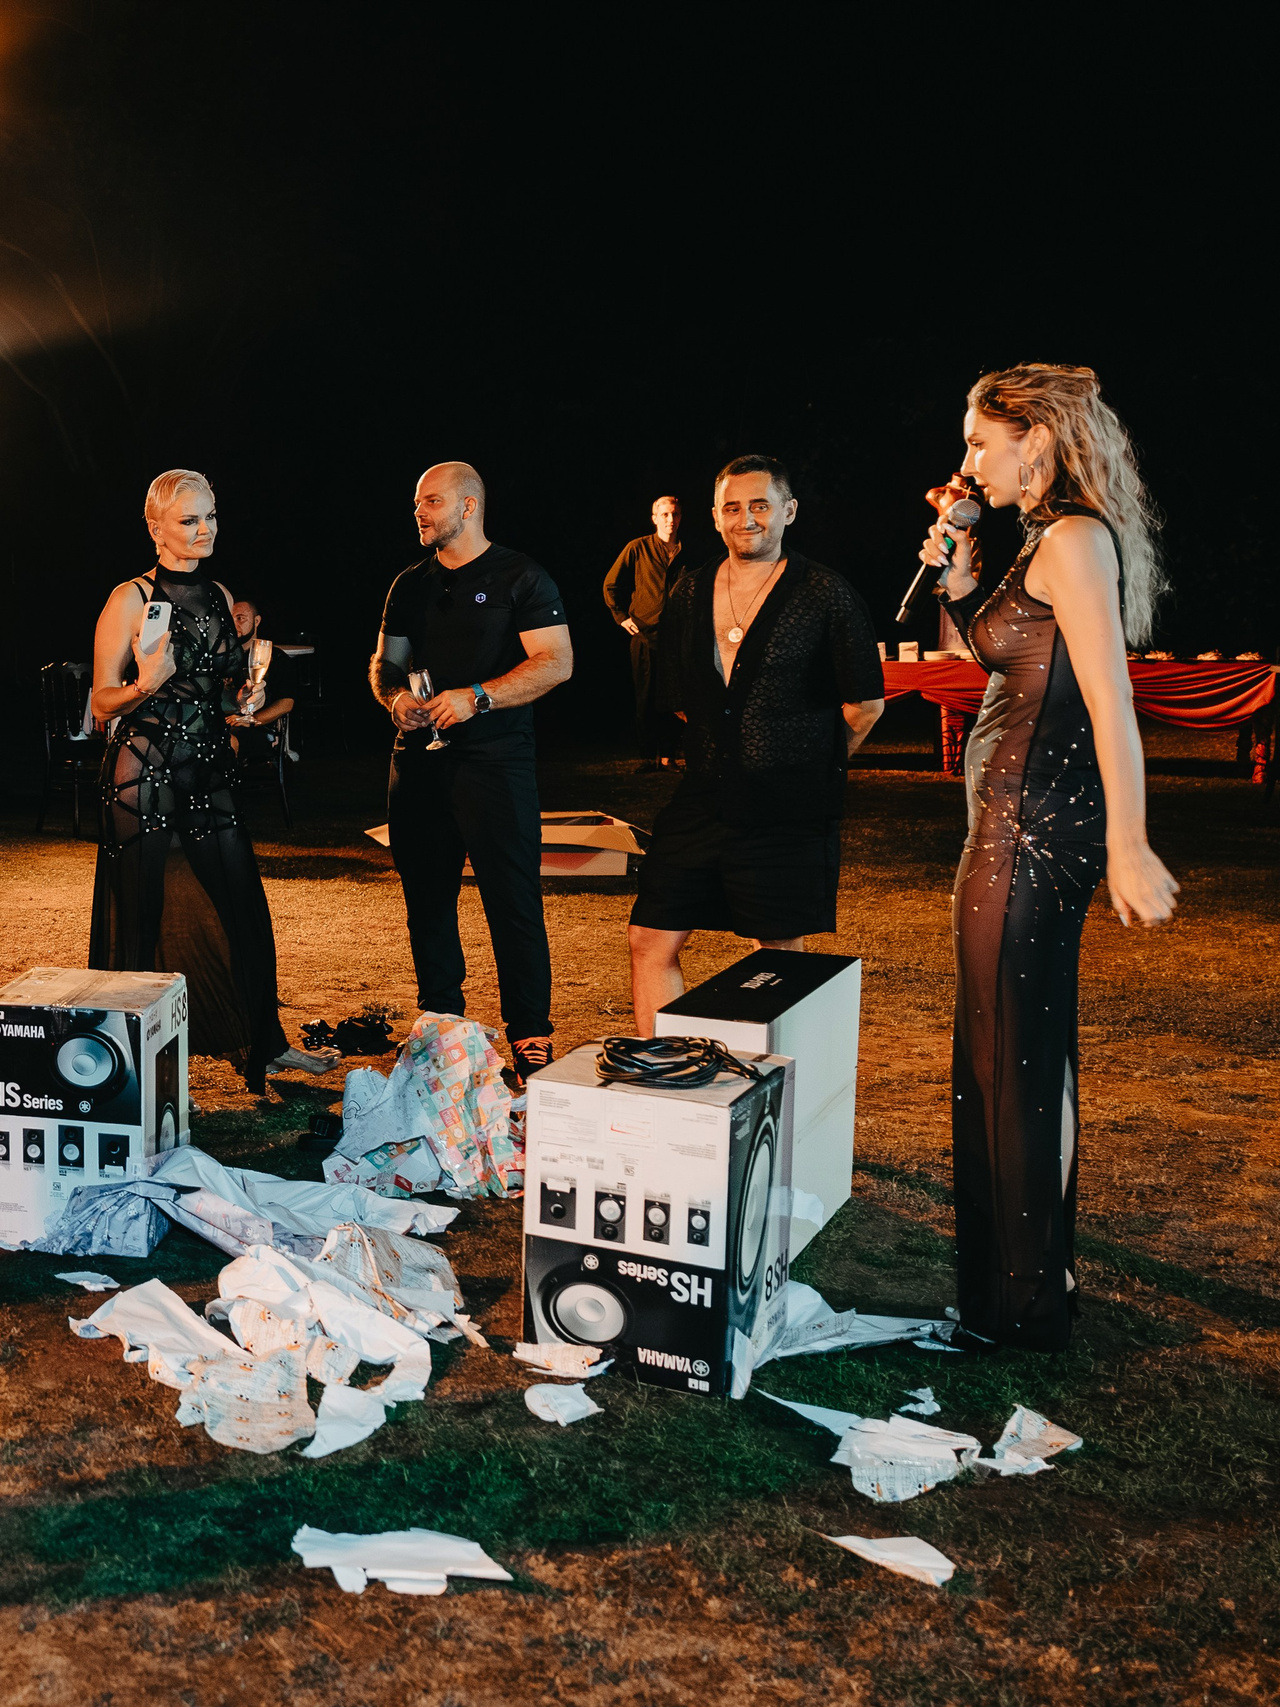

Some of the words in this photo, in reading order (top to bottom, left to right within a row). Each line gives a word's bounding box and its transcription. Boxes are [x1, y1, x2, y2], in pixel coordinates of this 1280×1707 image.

[1, 1024, 45, 1039] YAMAHA
[23, 1094, 63, 1111] Series
[617, 1260, 669, 1287] Series
[670, 1271, 712, 1308] HS
[637, 1346, 692, 1374] YAMAHA
